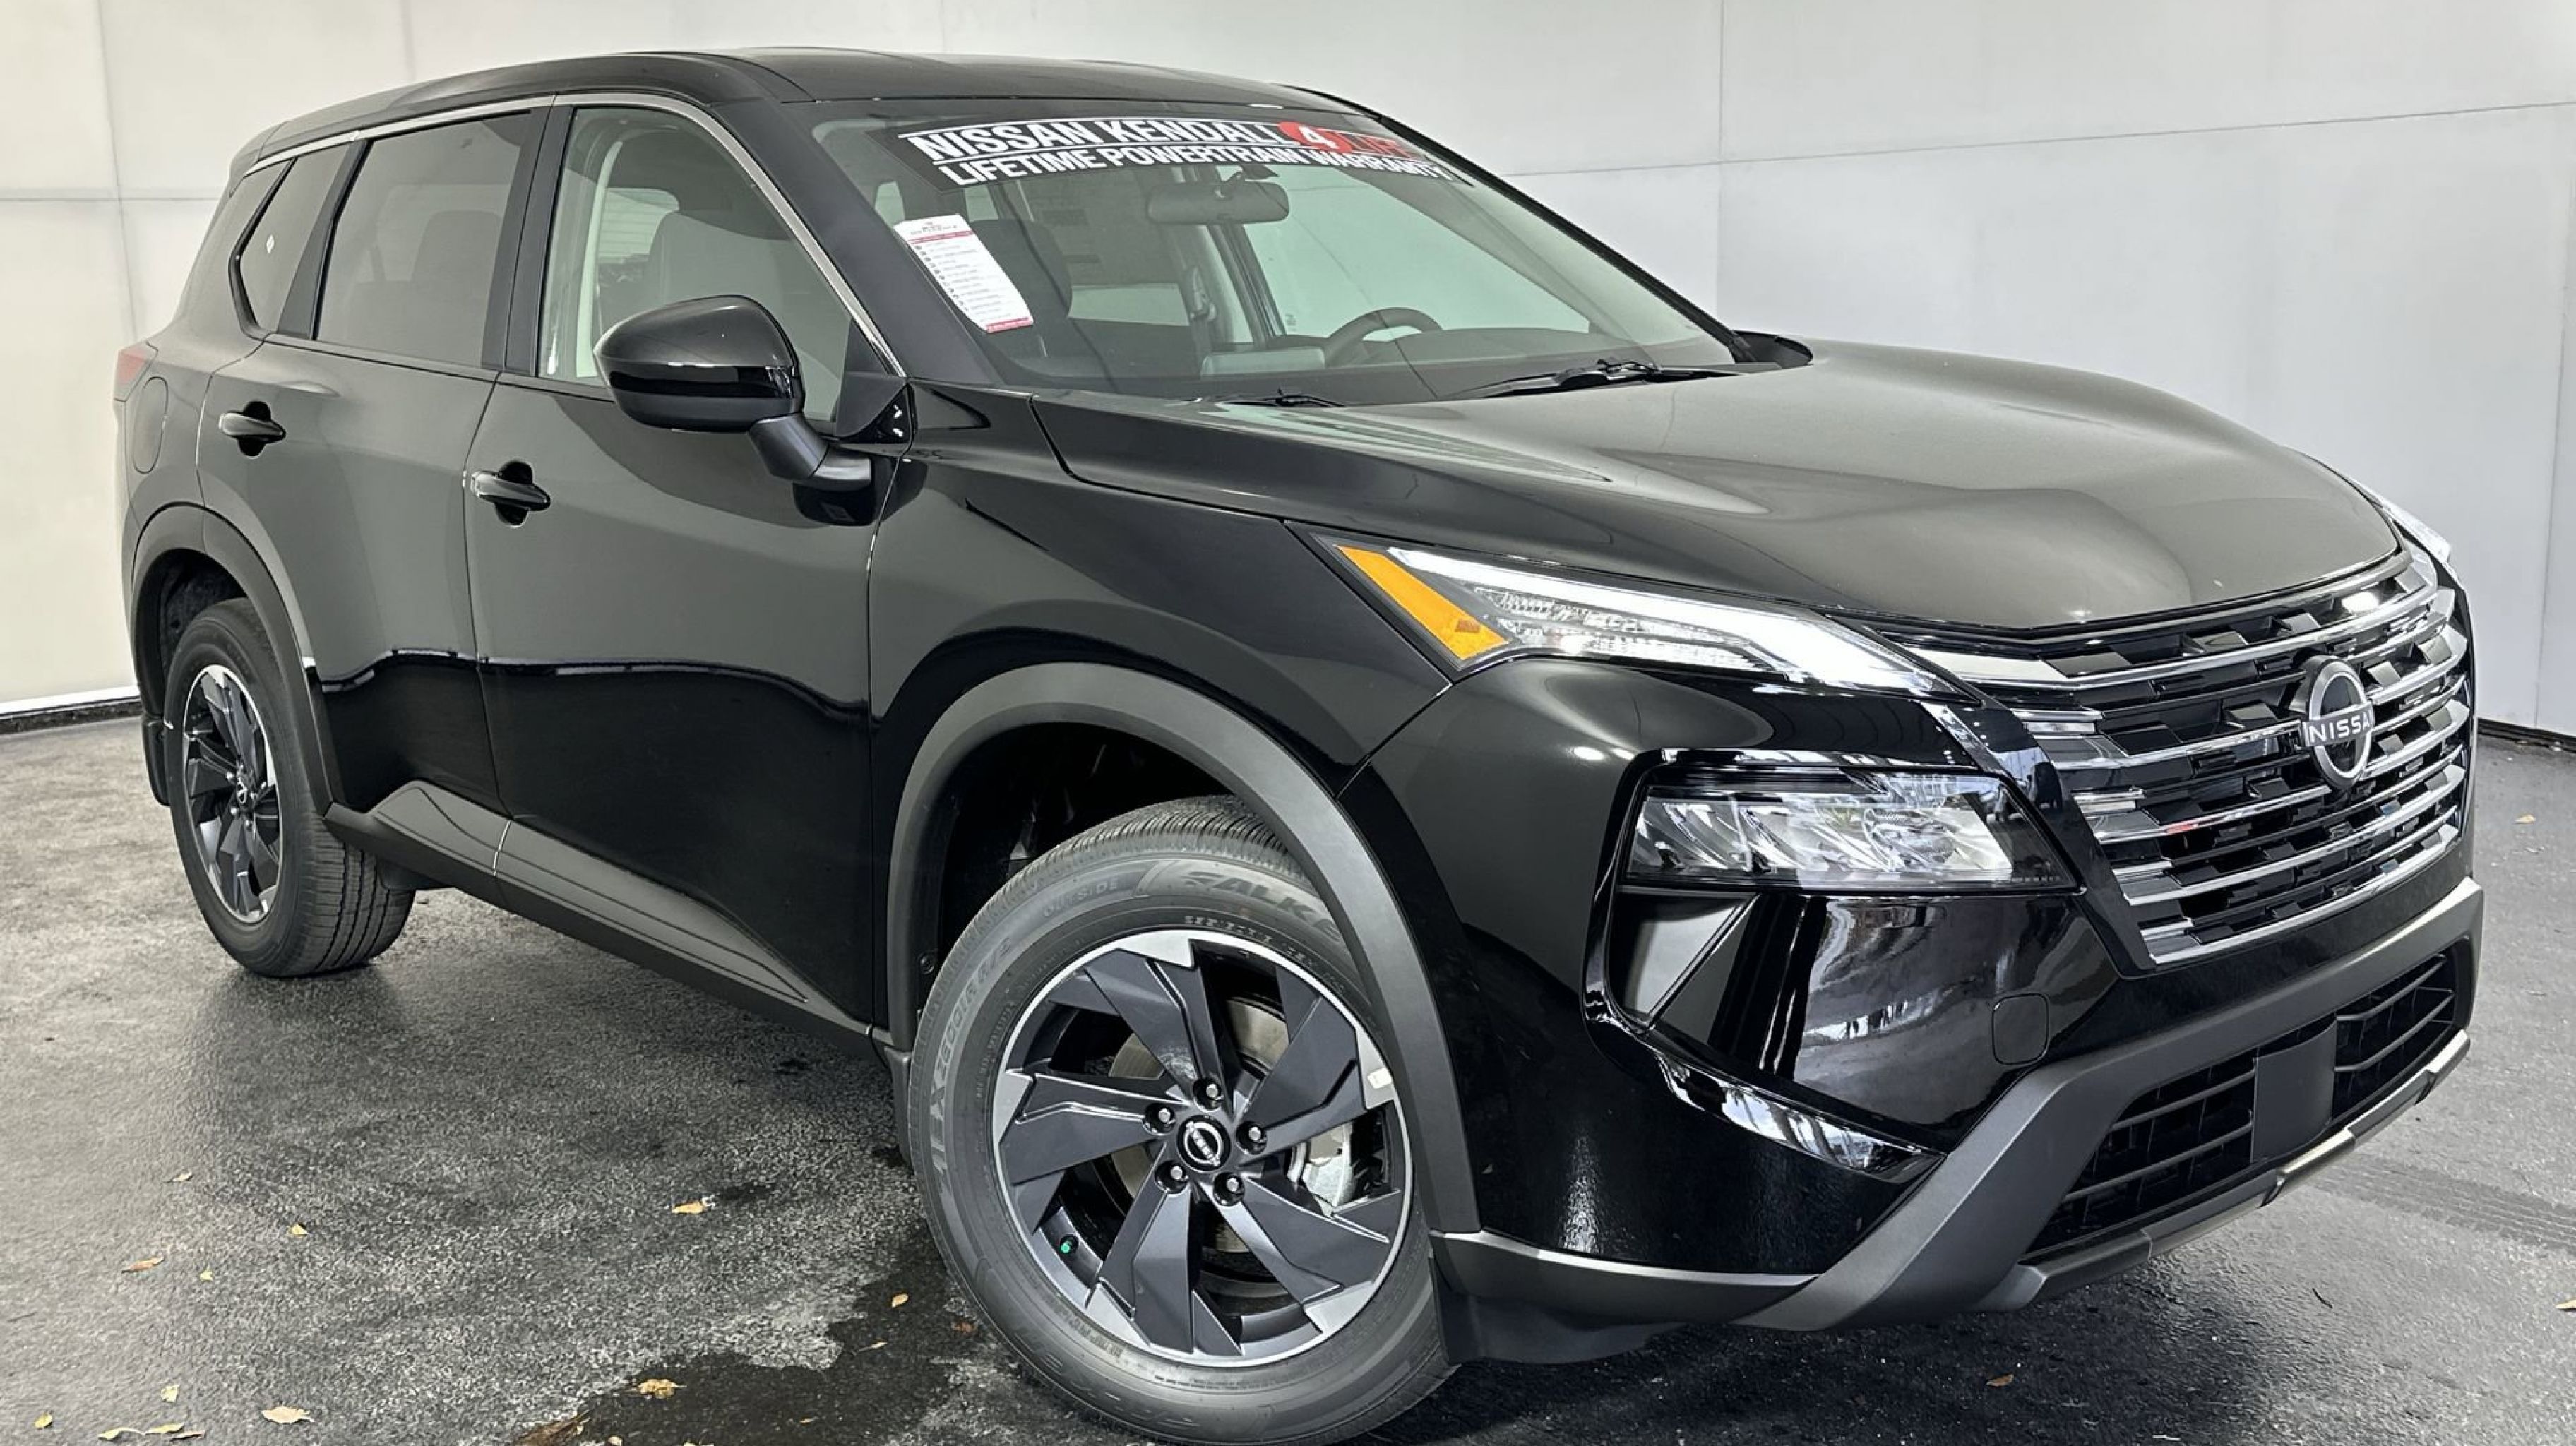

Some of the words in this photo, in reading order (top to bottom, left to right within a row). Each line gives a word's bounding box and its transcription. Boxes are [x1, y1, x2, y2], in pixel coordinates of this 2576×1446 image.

[907, 121, 1104, 160] NISSAN
[1095, 119, 1304, 145] KENDALL
[938, 149, 1109, 186] LIFETIME
[1097, 145, 1311, 167] POWERTRAIN
[1309, 149, 1453, 181] WARRANTY
[1181, 871, 1342, 942] FALKE
